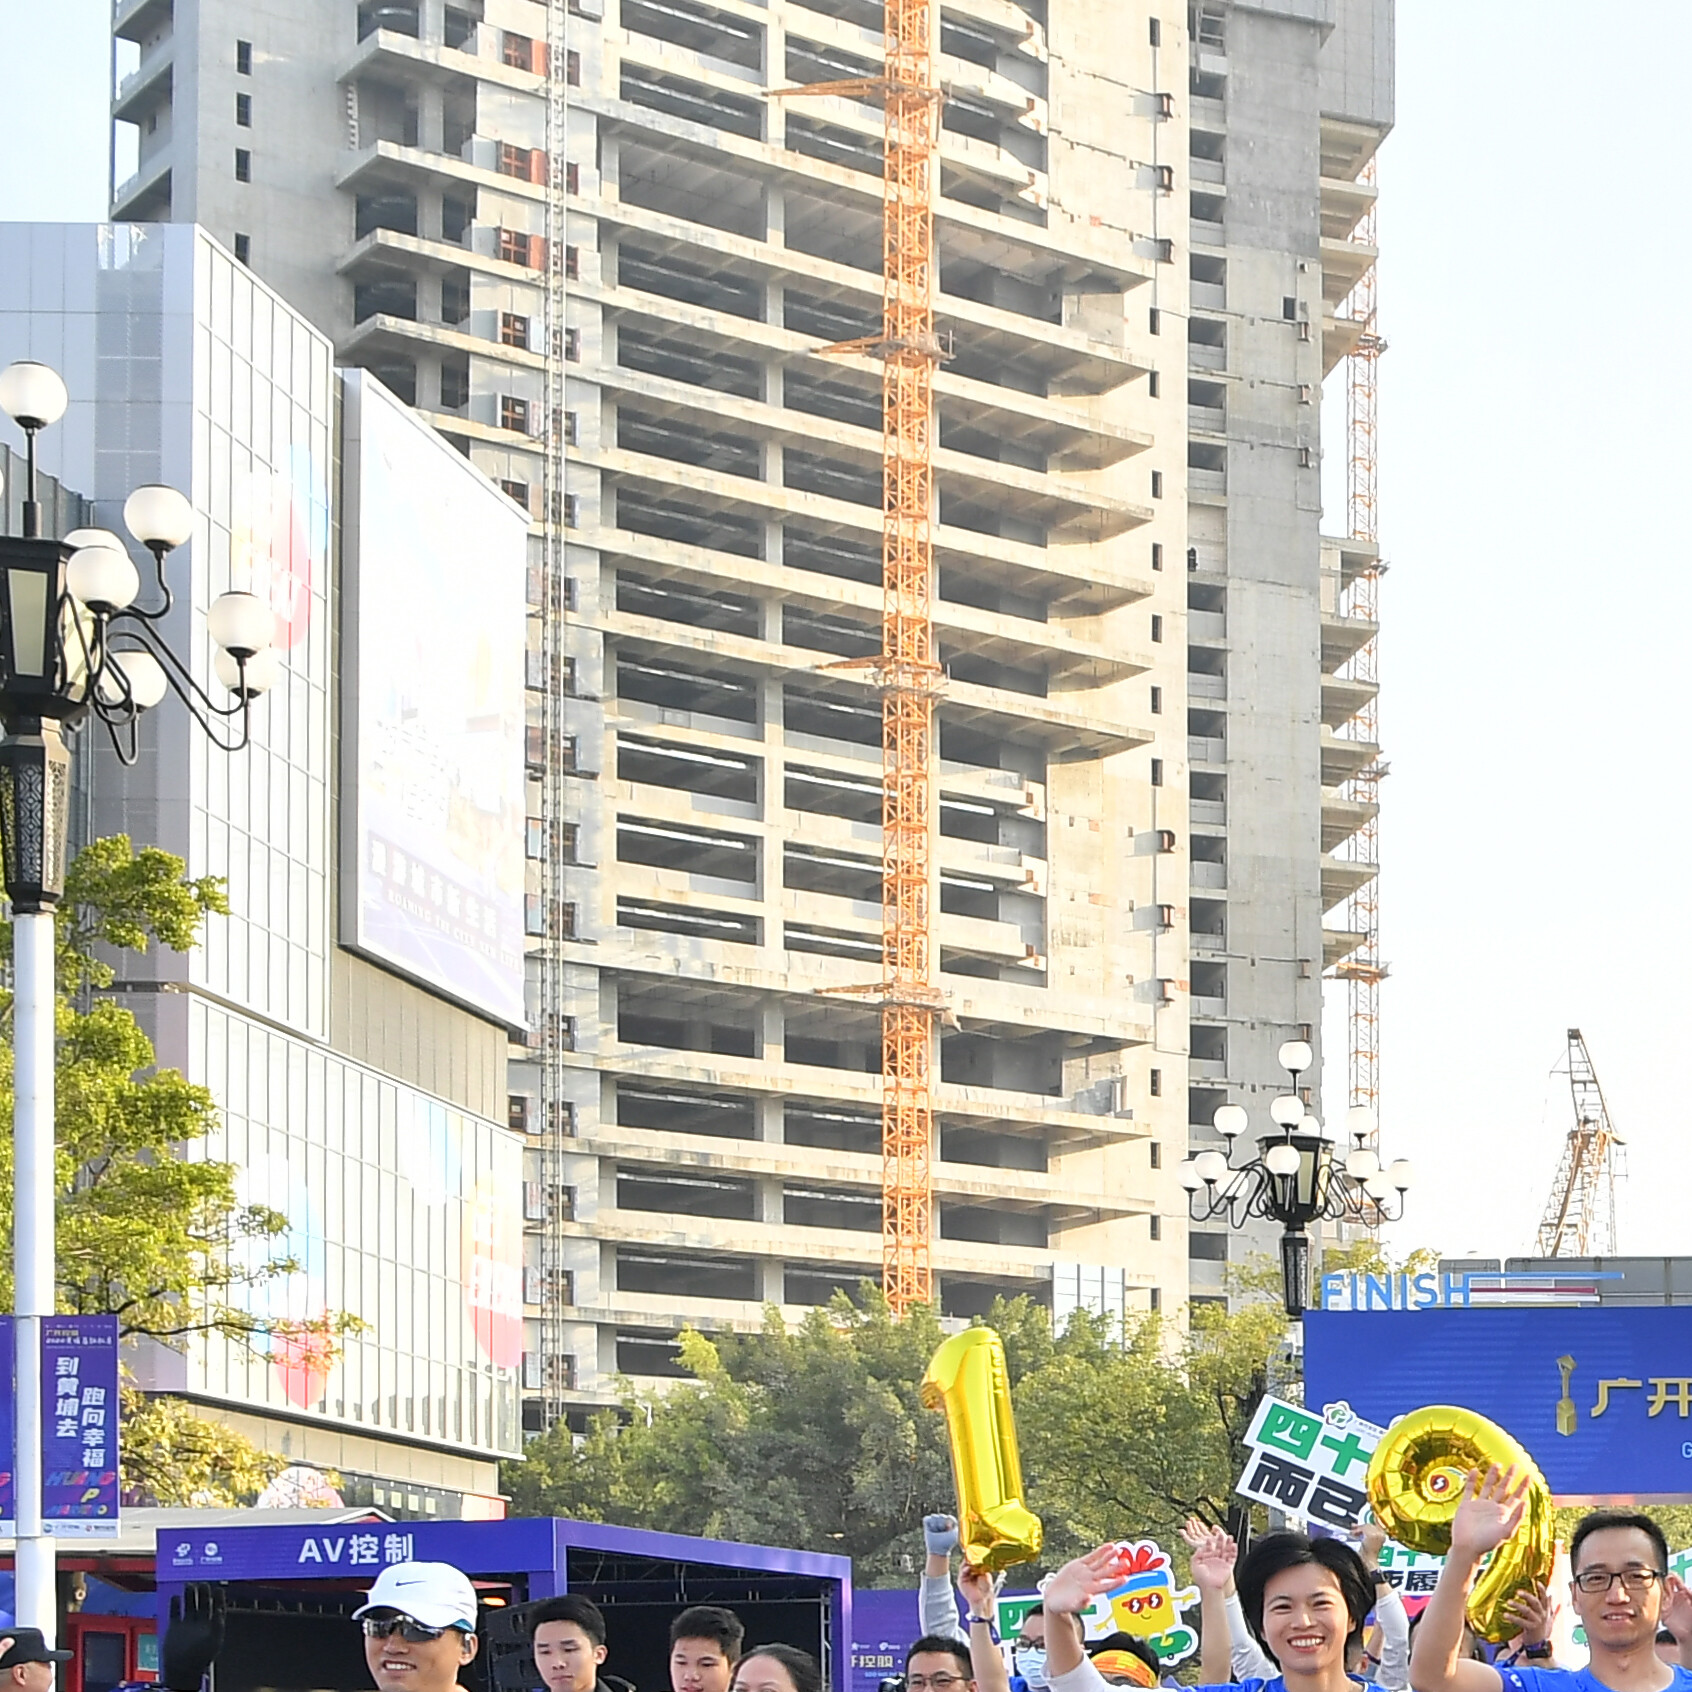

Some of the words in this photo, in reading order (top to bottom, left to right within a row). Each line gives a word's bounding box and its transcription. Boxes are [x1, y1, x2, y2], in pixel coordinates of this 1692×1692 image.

[1321, 1273, 1472, 1309] FINISH
[81, 1387, 105, 1468] 跑向幸福
[298, 1533, 415, 1566] AV控制
